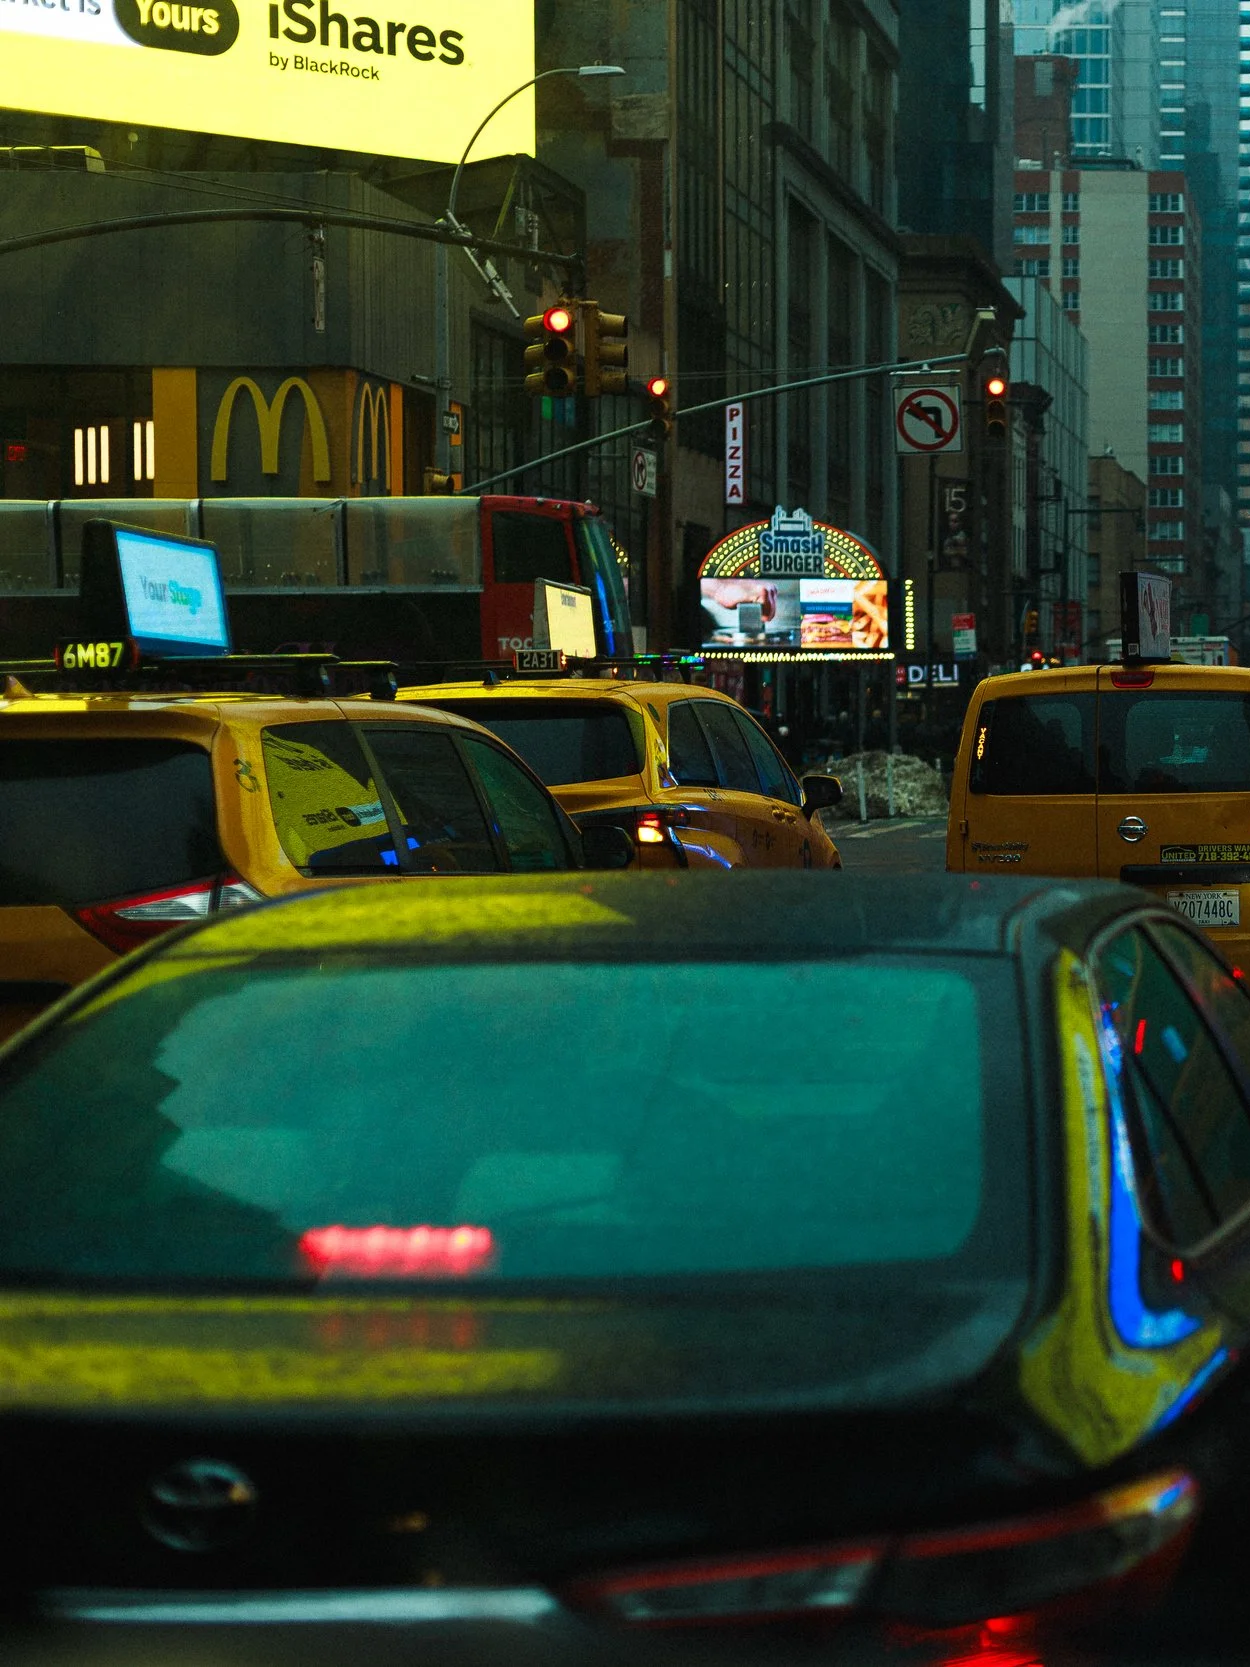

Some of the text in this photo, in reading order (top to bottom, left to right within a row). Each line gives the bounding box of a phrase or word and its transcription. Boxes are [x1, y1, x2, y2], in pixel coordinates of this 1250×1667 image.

[135, 0, 219, 35] Yours
[269, 0, 464, 66] iShares
[269, 52, 380, 80] by BlackRock
[728, 408, 741, 498] PIZZA
[944, 488, 966, 513] 15
[762, 554, 823, 573] BURGER
[63, 642, 125, 669] 6M87
[523, 652, 554, 669] 2A31
[908, 663, 958, 682] DELI
[976, 728, 987, 760] VACANT
[1162, 850, 1197, 860] UNITED
[1185, 892, 1223, 900] NEW YORK
